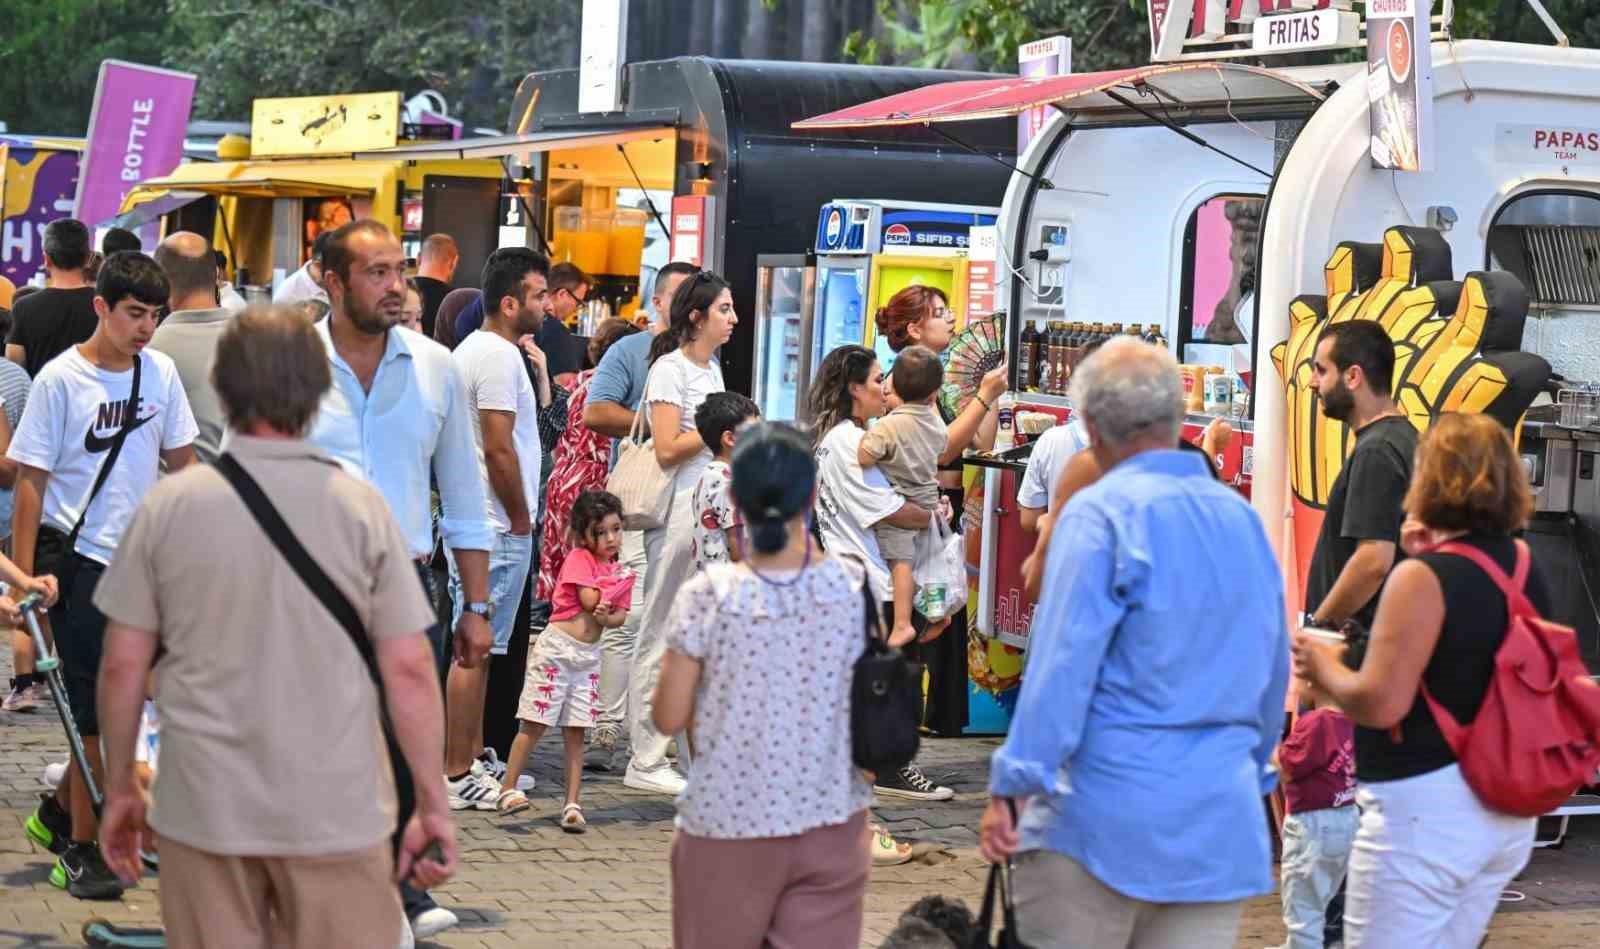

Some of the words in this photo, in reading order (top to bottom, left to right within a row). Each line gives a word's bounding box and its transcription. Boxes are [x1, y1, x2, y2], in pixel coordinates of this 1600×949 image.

[1372, 0, 1407, 12] CHURROS
[1269, 15, 1320, 44] FRITAS
[121, 98, 154, 181] BOTTLE
[1535, 130, 1599, 151] PAPAS
[1554, 151, 1577, 160] TEAM
[886, 234, 910, 242] PEPSI
[916, 233, 953, 245] SIFIR
[956, 235, 970, 248] Ş
